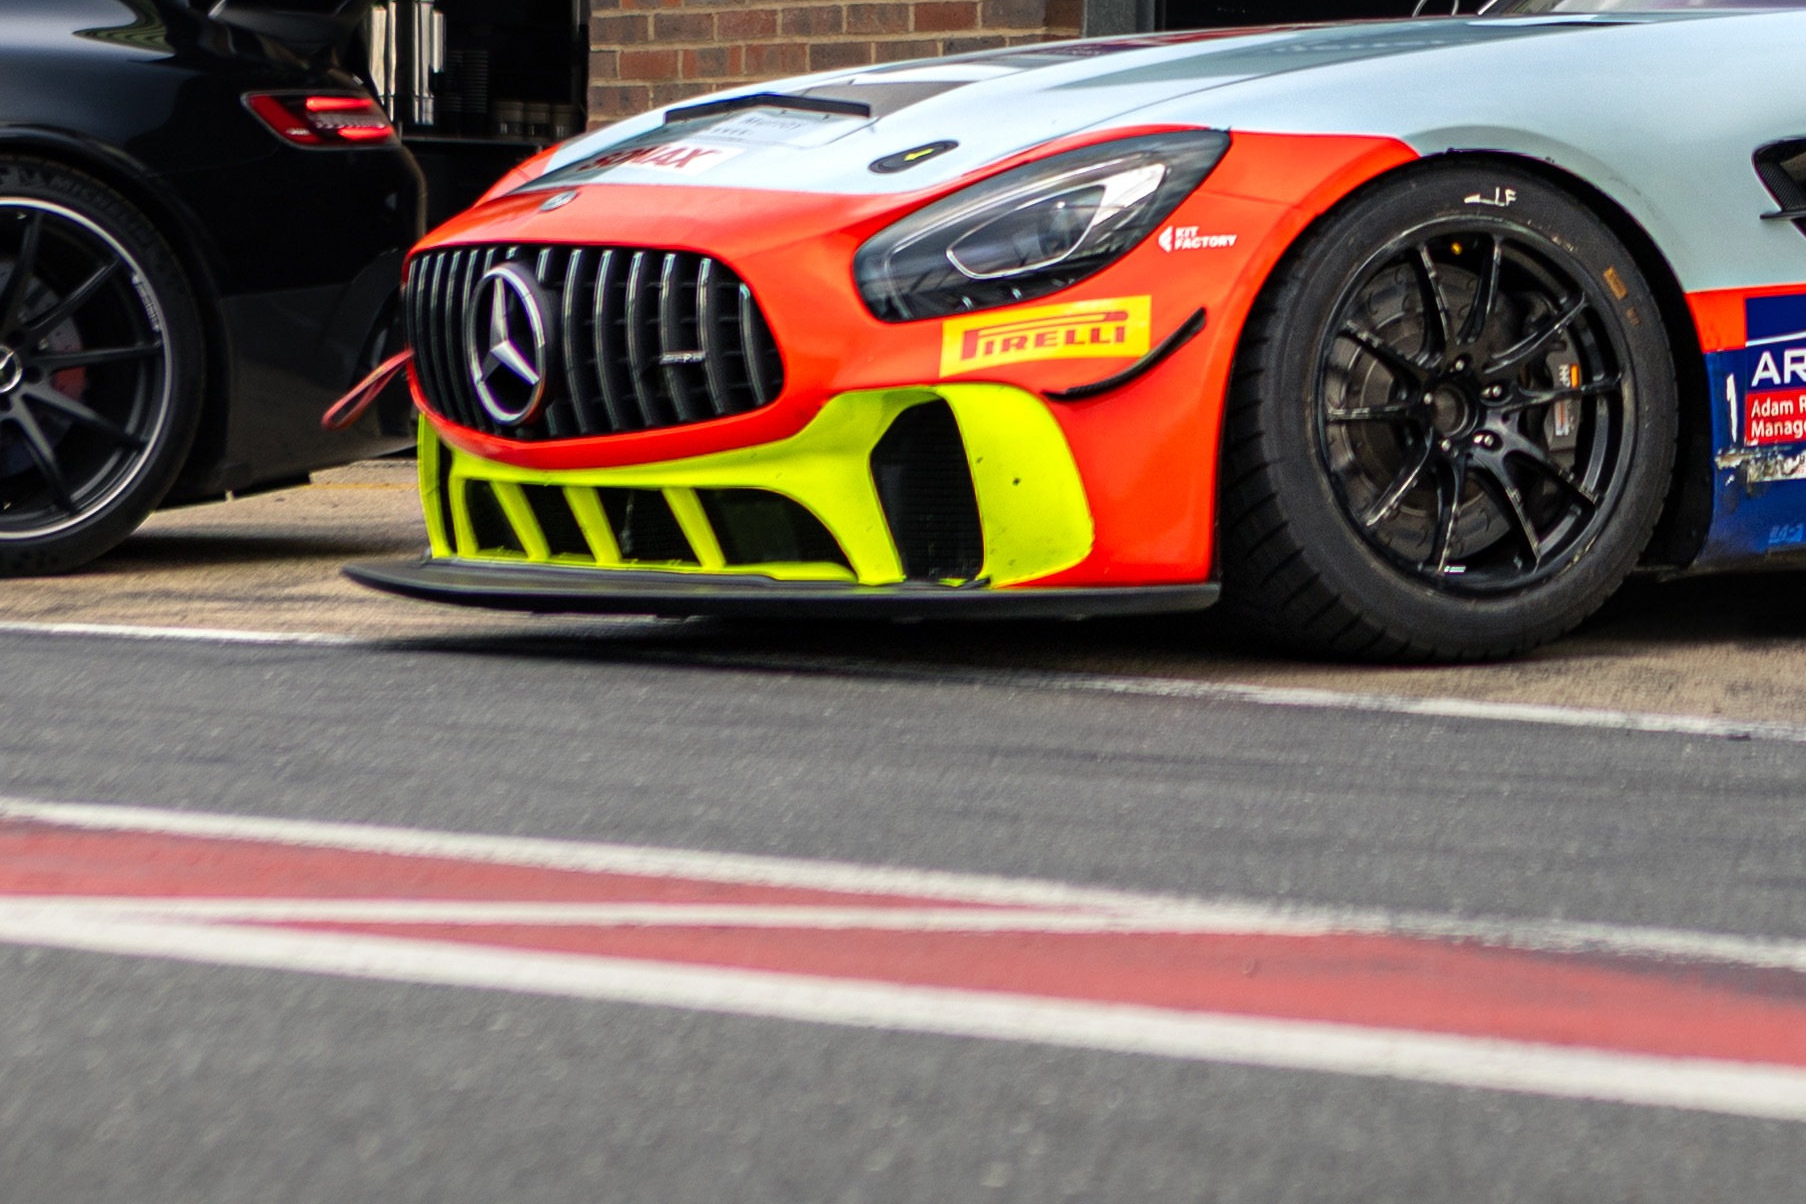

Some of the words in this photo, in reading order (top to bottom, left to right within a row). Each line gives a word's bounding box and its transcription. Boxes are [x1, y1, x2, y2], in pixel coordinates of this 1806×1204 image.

[1175, 226, 1199, 237] KIT
[1175, 234, 1237, 250] FACTORY
[960, 311, 1129, 361] PIRELLI
[1751, 397, 1794, 418] Adam
